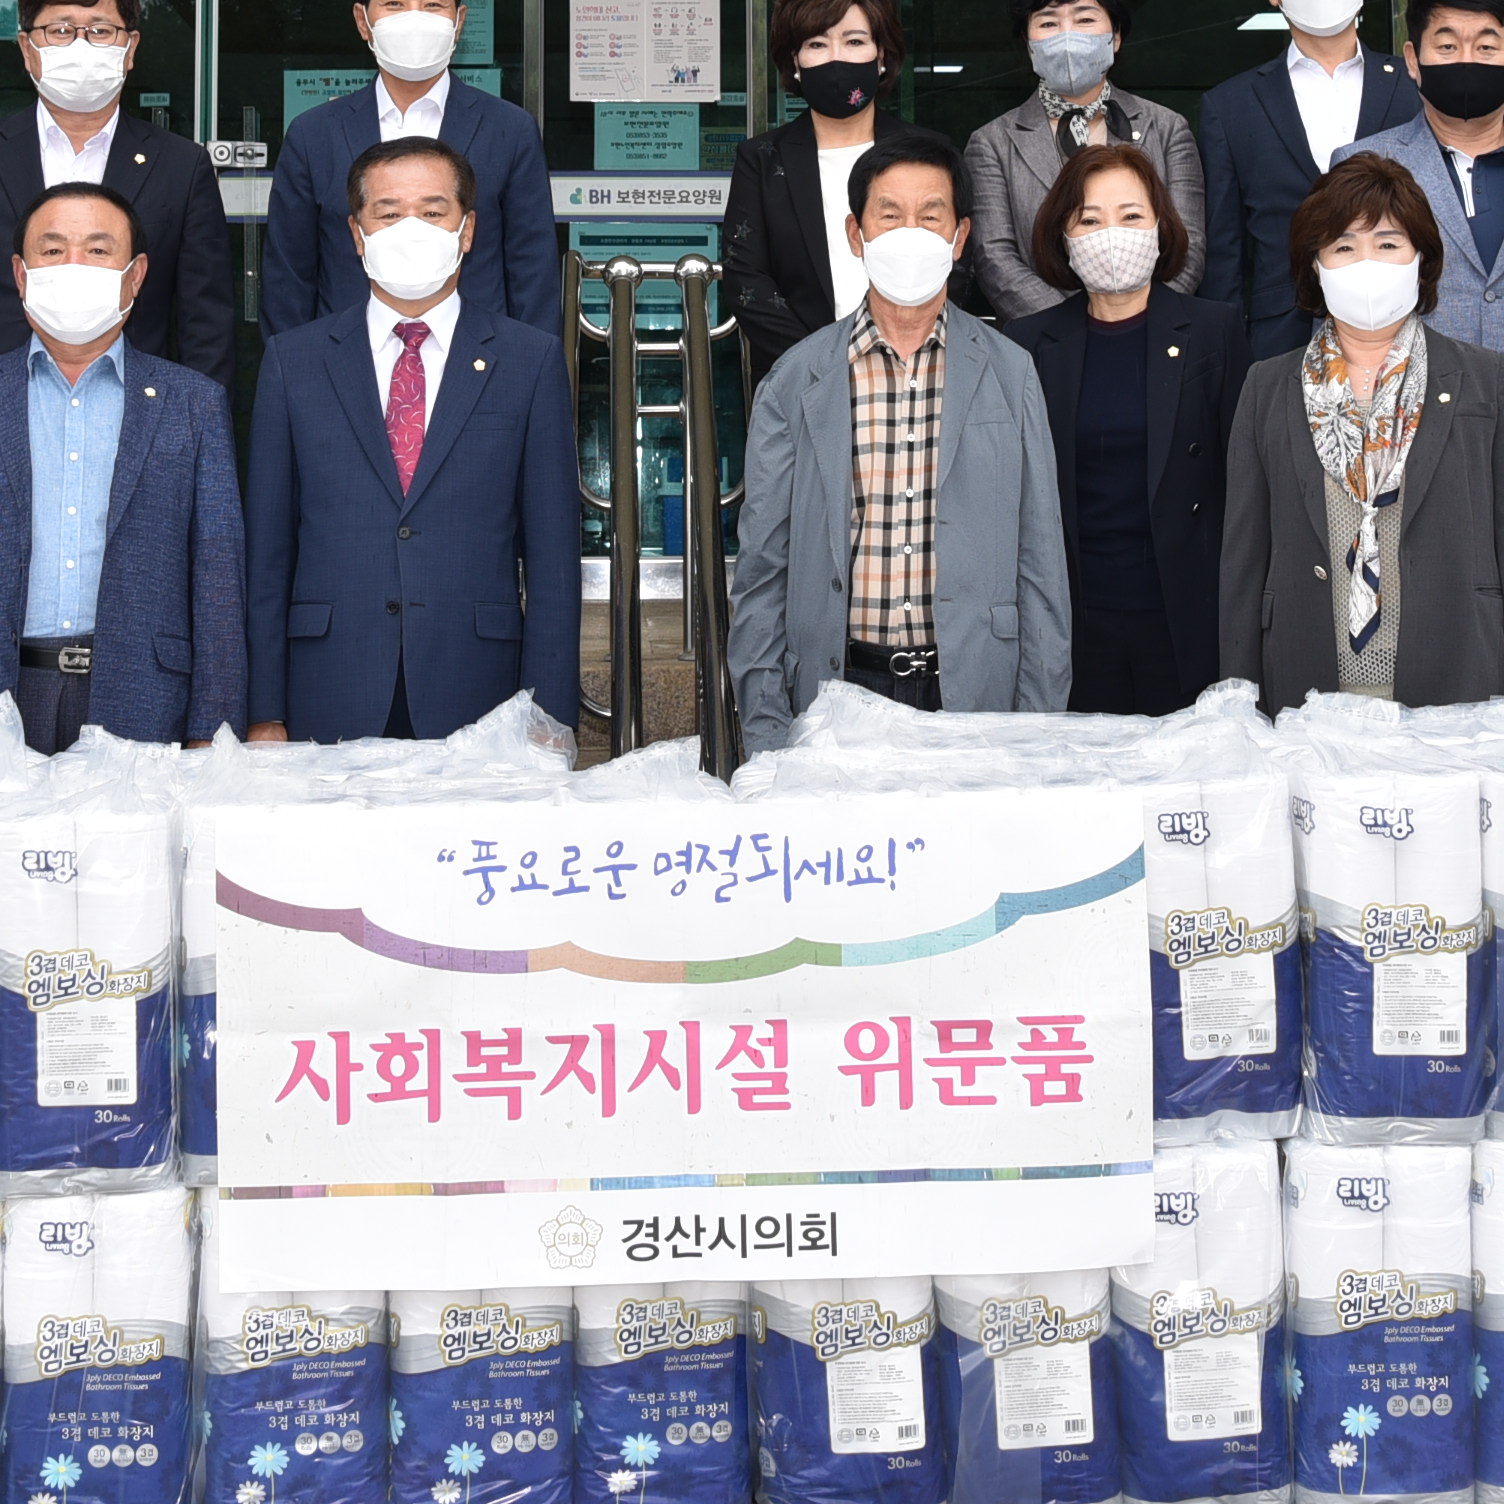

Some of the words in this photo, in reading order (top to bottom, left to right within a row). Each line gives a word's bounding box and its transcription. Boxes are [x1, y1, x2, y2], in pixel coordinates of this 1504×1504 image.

[589, 189, 611, 205] BH
[616, 189, 722, 205] 보현전문요양원
[1366, 908, 1391, 929] 3겹
[1396, 907, 1424, 924] 데코
[1364, 920, 1441, 956] 엠보싱
[1442, 927, 1475, 948] 화장지
[275, 1019, 793, 1125] 사회복지시설
[838, 1014, 1094, 1110] 위문품
[1427, 1060, 1444, 1072] 30
[556, 1231, 589, 1248] 의회
[621, 1212, 838, 1262] 경산시의회
[816, 1306, 843, 1328] 3겹
[846, 1304, 875, 1323] 데코
[43, 1320, 69, 1341] 3겹
[73, 1319, 102, 1337] 데코
[816, 1315, 892, 1357] 엠보싱
[894, 1321, 929, 1343] 화장지
[39, 1332, 118, 1373] 엠보싱
[120, 1340, 160, 1361] 화장지
[86, 1382, 121, 1391] Bathroom
[123, 1382, 148, 1390] Tissues
[102, 1373, 123, 1381] DECO
[47, 1411, 87, 1424] 부드럽고
[62, 1427, 82, 1441] 3겹
[88, 1426, 112, 1439] 데코
[117, 1425, 154, 1440] 화장지
[887, 1456, 904, 1470] 30
